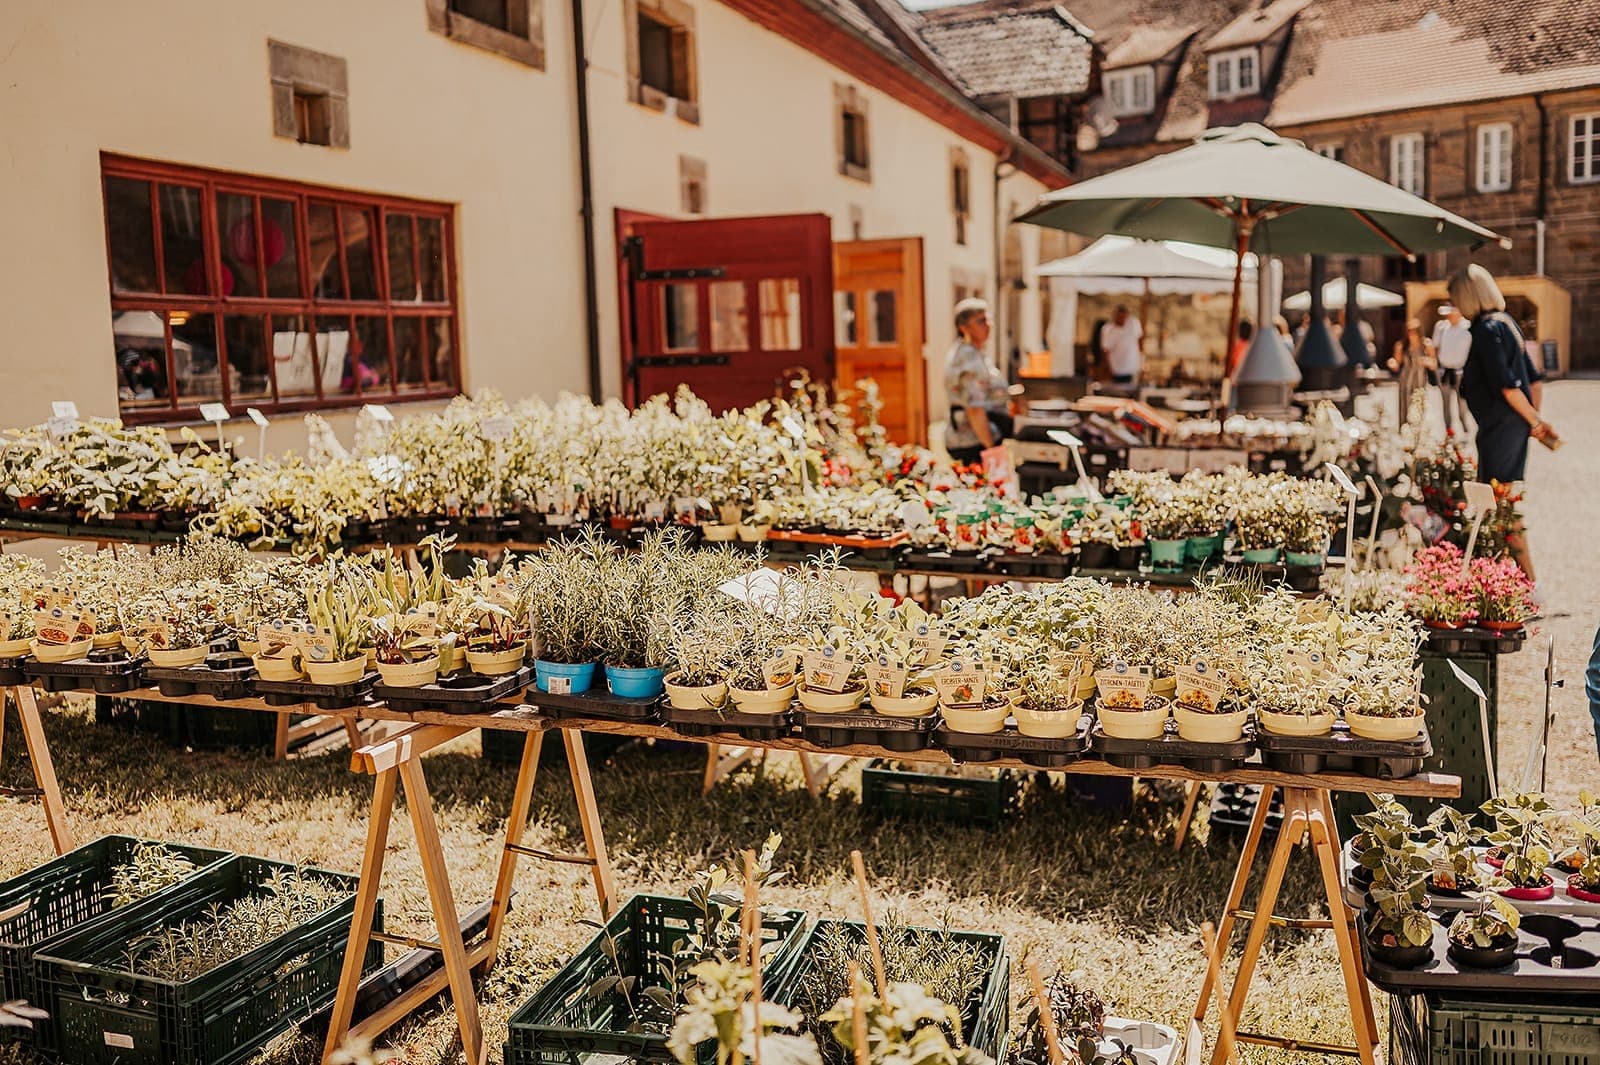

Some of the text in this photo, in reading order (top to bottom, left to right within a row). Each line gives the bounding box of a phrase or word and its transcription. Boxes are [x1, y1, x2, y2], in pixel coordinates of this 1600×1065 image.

[819, 661, 836, 670] SALBEI
[941, 677, 979, 685] ERDBEER-MINZE
[1100, 678, 1145, 688] ZITRONEN-TAGETES
[1179, 674, 1221, 692] ZITRONEN-TAGETES
